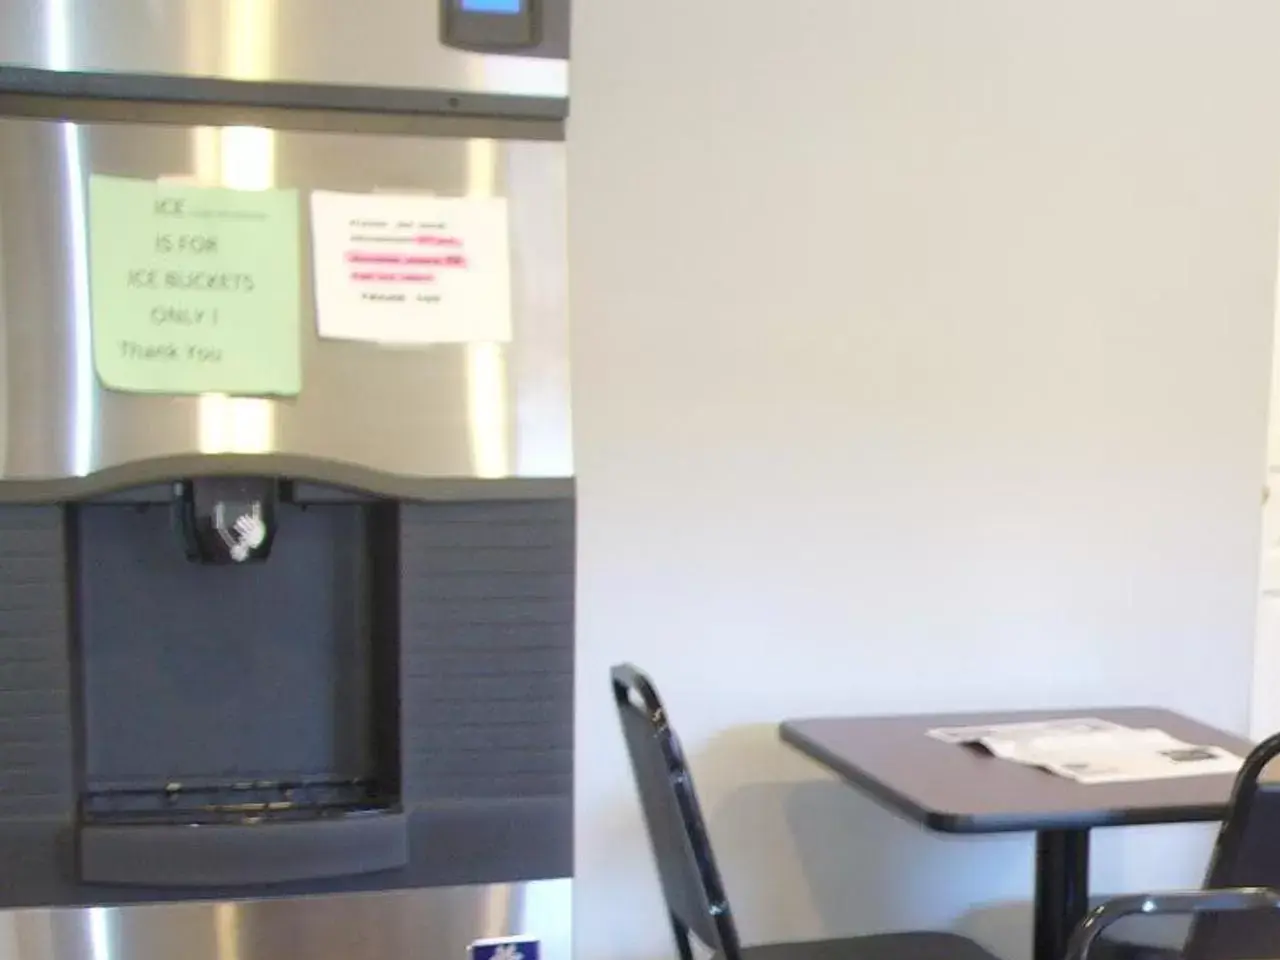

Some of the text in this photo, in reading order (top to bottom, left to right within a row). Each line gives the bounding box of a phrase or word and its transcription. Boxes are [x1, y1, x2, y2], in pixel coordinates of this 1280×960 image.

[153, 198, 185, 216] ICE
[155, 233, 218, 253] IS FOR
[127, 269, 255, 291] ICE BUCKETS
[150, 306, 204, 326] ONLY
[117, 340, 223, 362] Thank You
